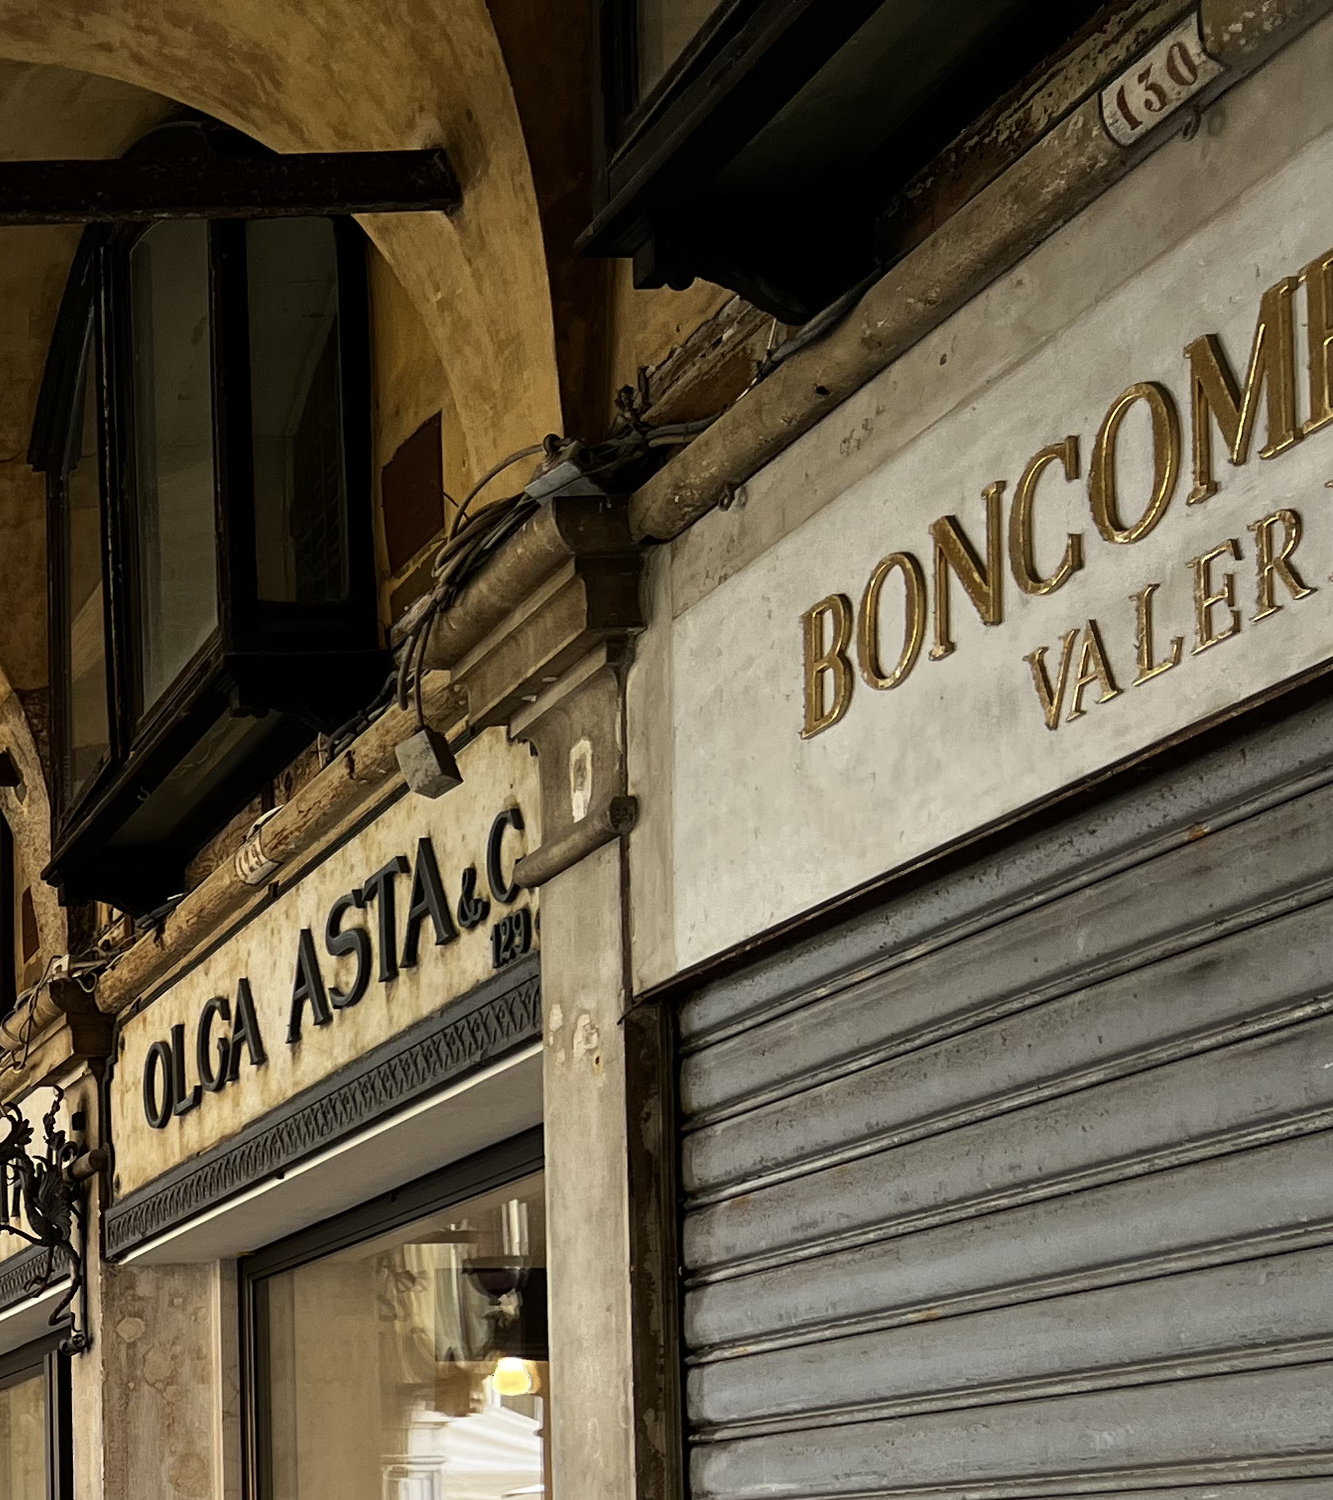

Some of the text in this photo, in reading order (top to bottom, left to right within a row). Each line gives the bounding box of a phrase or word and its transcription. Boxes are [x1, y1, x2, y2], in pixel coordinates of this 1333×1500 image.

[1115, 40, 1199, 132] 130
[143, 976, 267, 1130] OLGA
[285, 836, 460, 1046] ASTA
[458, 866, 490, 930] &
